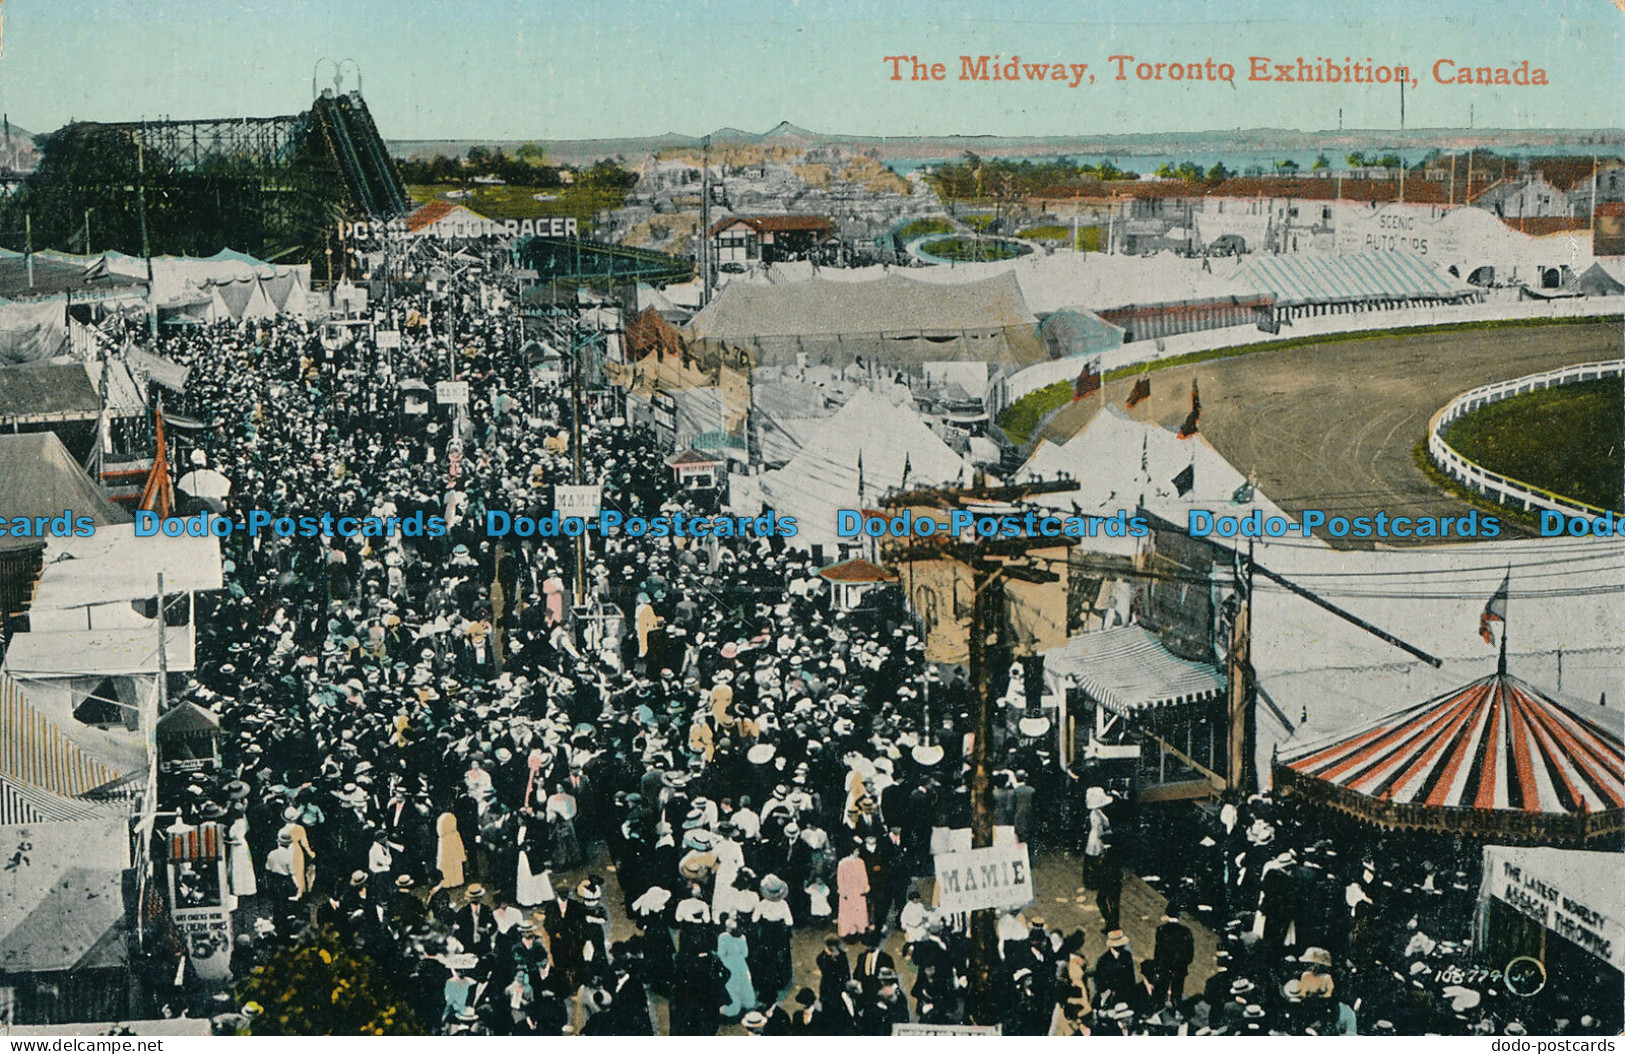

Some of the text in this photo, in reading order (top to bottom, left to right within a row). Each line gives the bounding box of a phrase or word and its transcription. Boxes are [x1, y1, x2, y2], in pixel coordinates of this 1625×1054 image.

[504, 217, 577, 237] RACER
[1366, 233, 1396, 252] AUTO
[941, 860, 1026, 894] MAMIE
[1503, 861, 1522, 883] THE
[1523, 873, 1560, 906] LATEST
